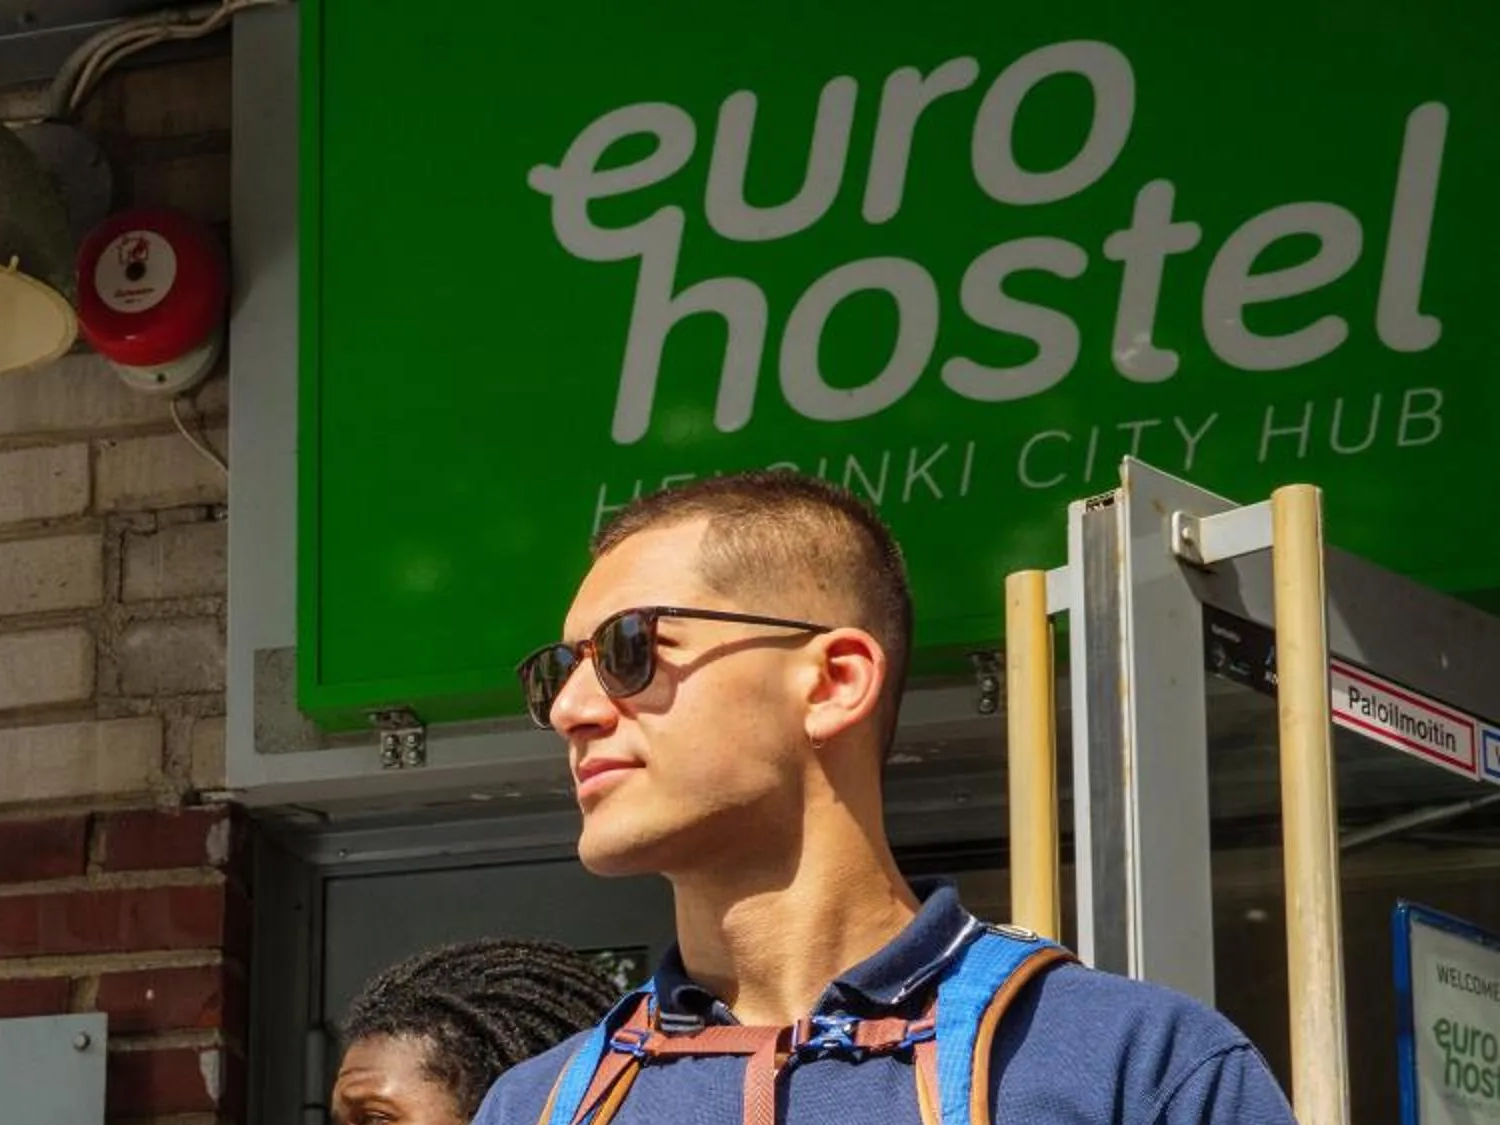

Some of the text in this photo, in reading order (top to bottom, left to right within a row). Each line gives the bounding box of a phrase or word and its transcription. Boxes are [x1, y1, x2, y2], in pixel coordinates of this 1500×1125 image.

[527, 39, 1137, 262] euro
[610, 101, 1450, 445] hostel
[592, 388, 1444, 539] HNKI CITY HUB
[1347, 685, 1457, 753] Paloilmoitin
[1432, 1017, 1498, 1063] euro
